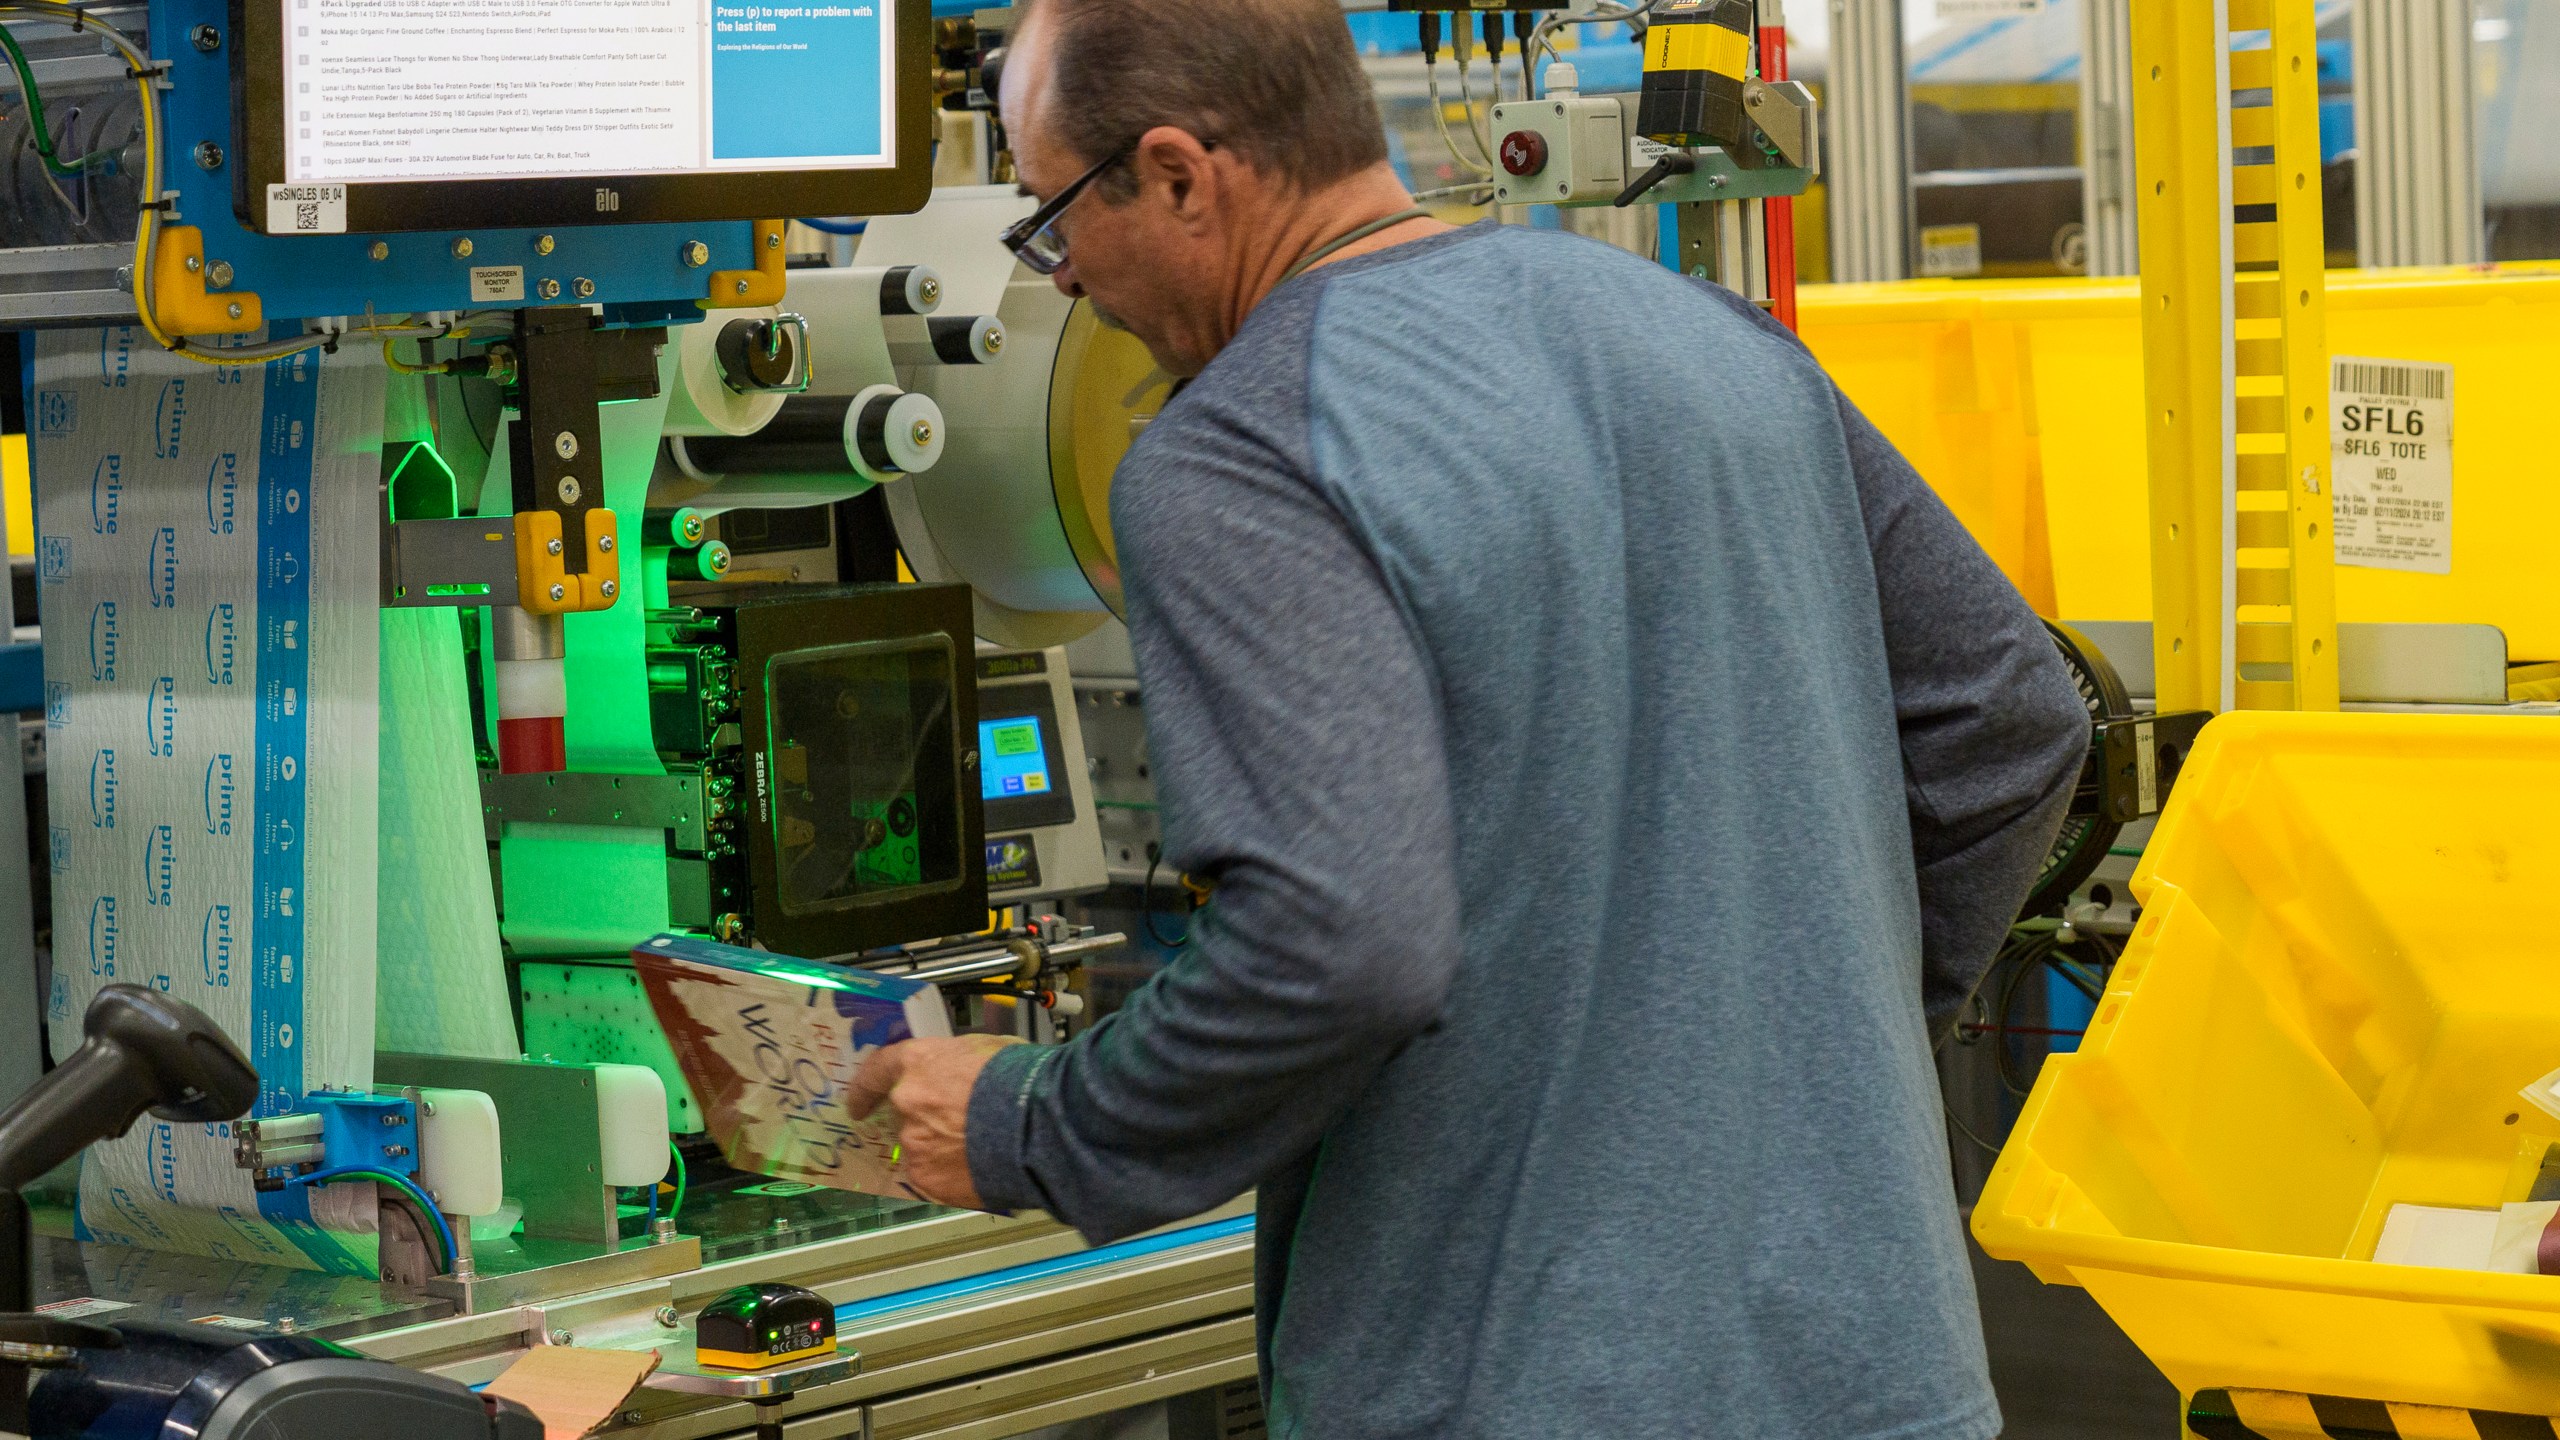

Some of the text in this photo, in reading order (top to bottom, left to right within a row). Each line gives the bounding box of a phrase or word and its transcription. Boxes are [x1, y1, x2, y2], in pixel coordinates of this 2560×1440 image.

[716, 6, 872, 19] Press (p) to report a problem with
[716, 21, 776, 32] the last item
[716, 43, 741, 52] Exploring
[751, 43, 775, 52] Religions
[1662, 27, 1671, 68] COGNEX
[273, 188, 342, 203] wsSINGLES_05_04
[116, 326, 133, 388] rime
[171, 378, 187, 459] prime
[270, 415, 280, 454] delivery
[2342, 404, 2424, 436] SFL6
[107, 454, 123, 534] prime
[222, 452, 236, 535] prime
[2376, 467, 2397, 481] WED
[267, 477, 275, 525] streaming
[2353, 504, 2368, 516] Date
[162, 527, 179, 609] prime
[267, 546, 275, 588] listening
[103, 602, 120, 682] prime
[219, 603, 237, 686] prime
[266, 616, 274, 652] reading
[159, 676, 178, 758] prime
[265, 681, 273, 720] delivery
[101, 749, 119, 829] prime
[264, 743, 272, 792] streaming
[756, 752, 766, 797] ZEBRA
[218, 753, 235, 837] prime
[263, 813, 271, 854] listening
[158, 824, 177, 907] prime
[262, 882, 271, 919] reading
[102, 896, 116, 977] prime
[216, 904, 231, 988] prime
[262, 948, 270, 987] delivery
[261, 1009, 269, 1058] streaming
[738, 1003, 843, 1169] WORLD
